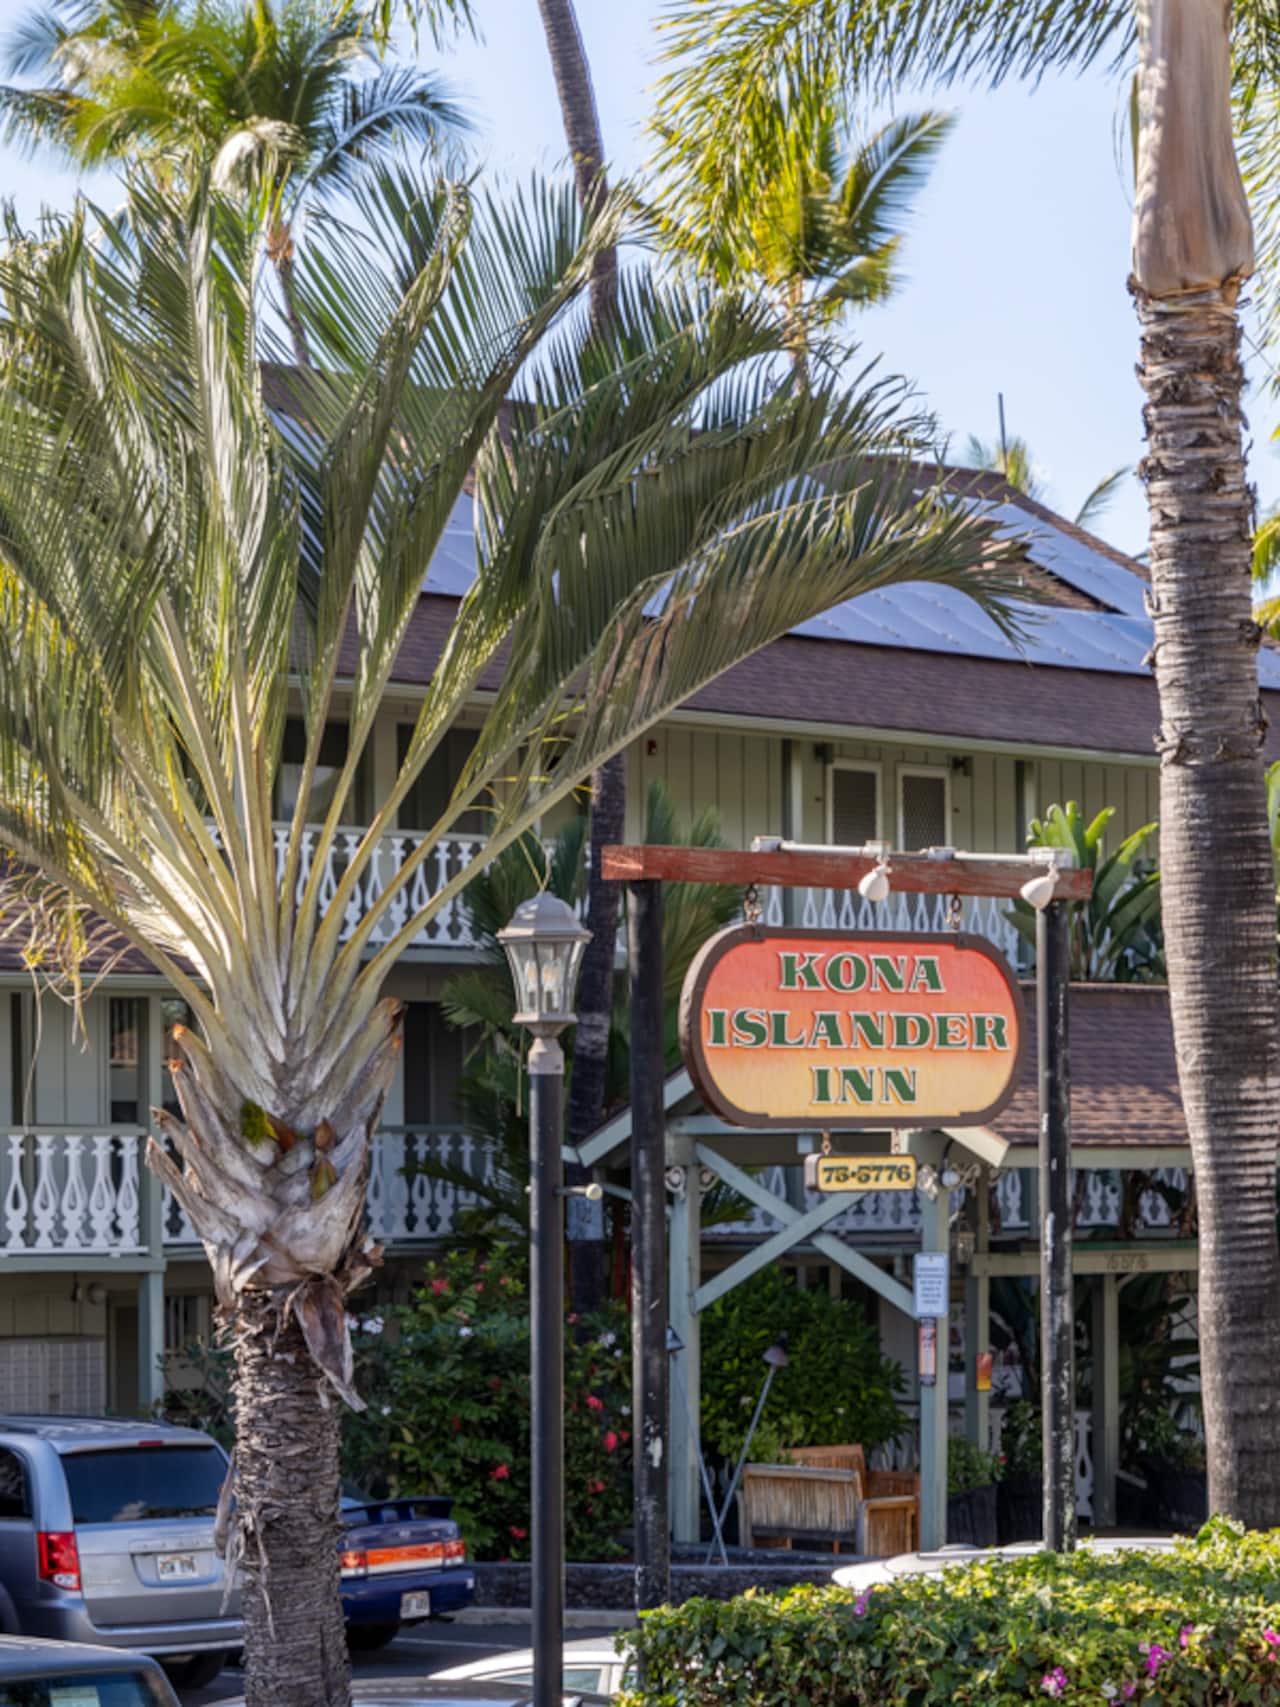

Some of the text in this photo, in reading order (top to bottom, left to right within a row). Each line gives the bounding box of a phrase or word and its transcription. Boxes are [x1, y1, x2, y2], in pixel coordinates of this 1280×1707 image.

[778, 951, 946, 993] KONA
[707, 1008, 1009, 1050] ISLANDER
[810, 1065, 918, 1105] INN
